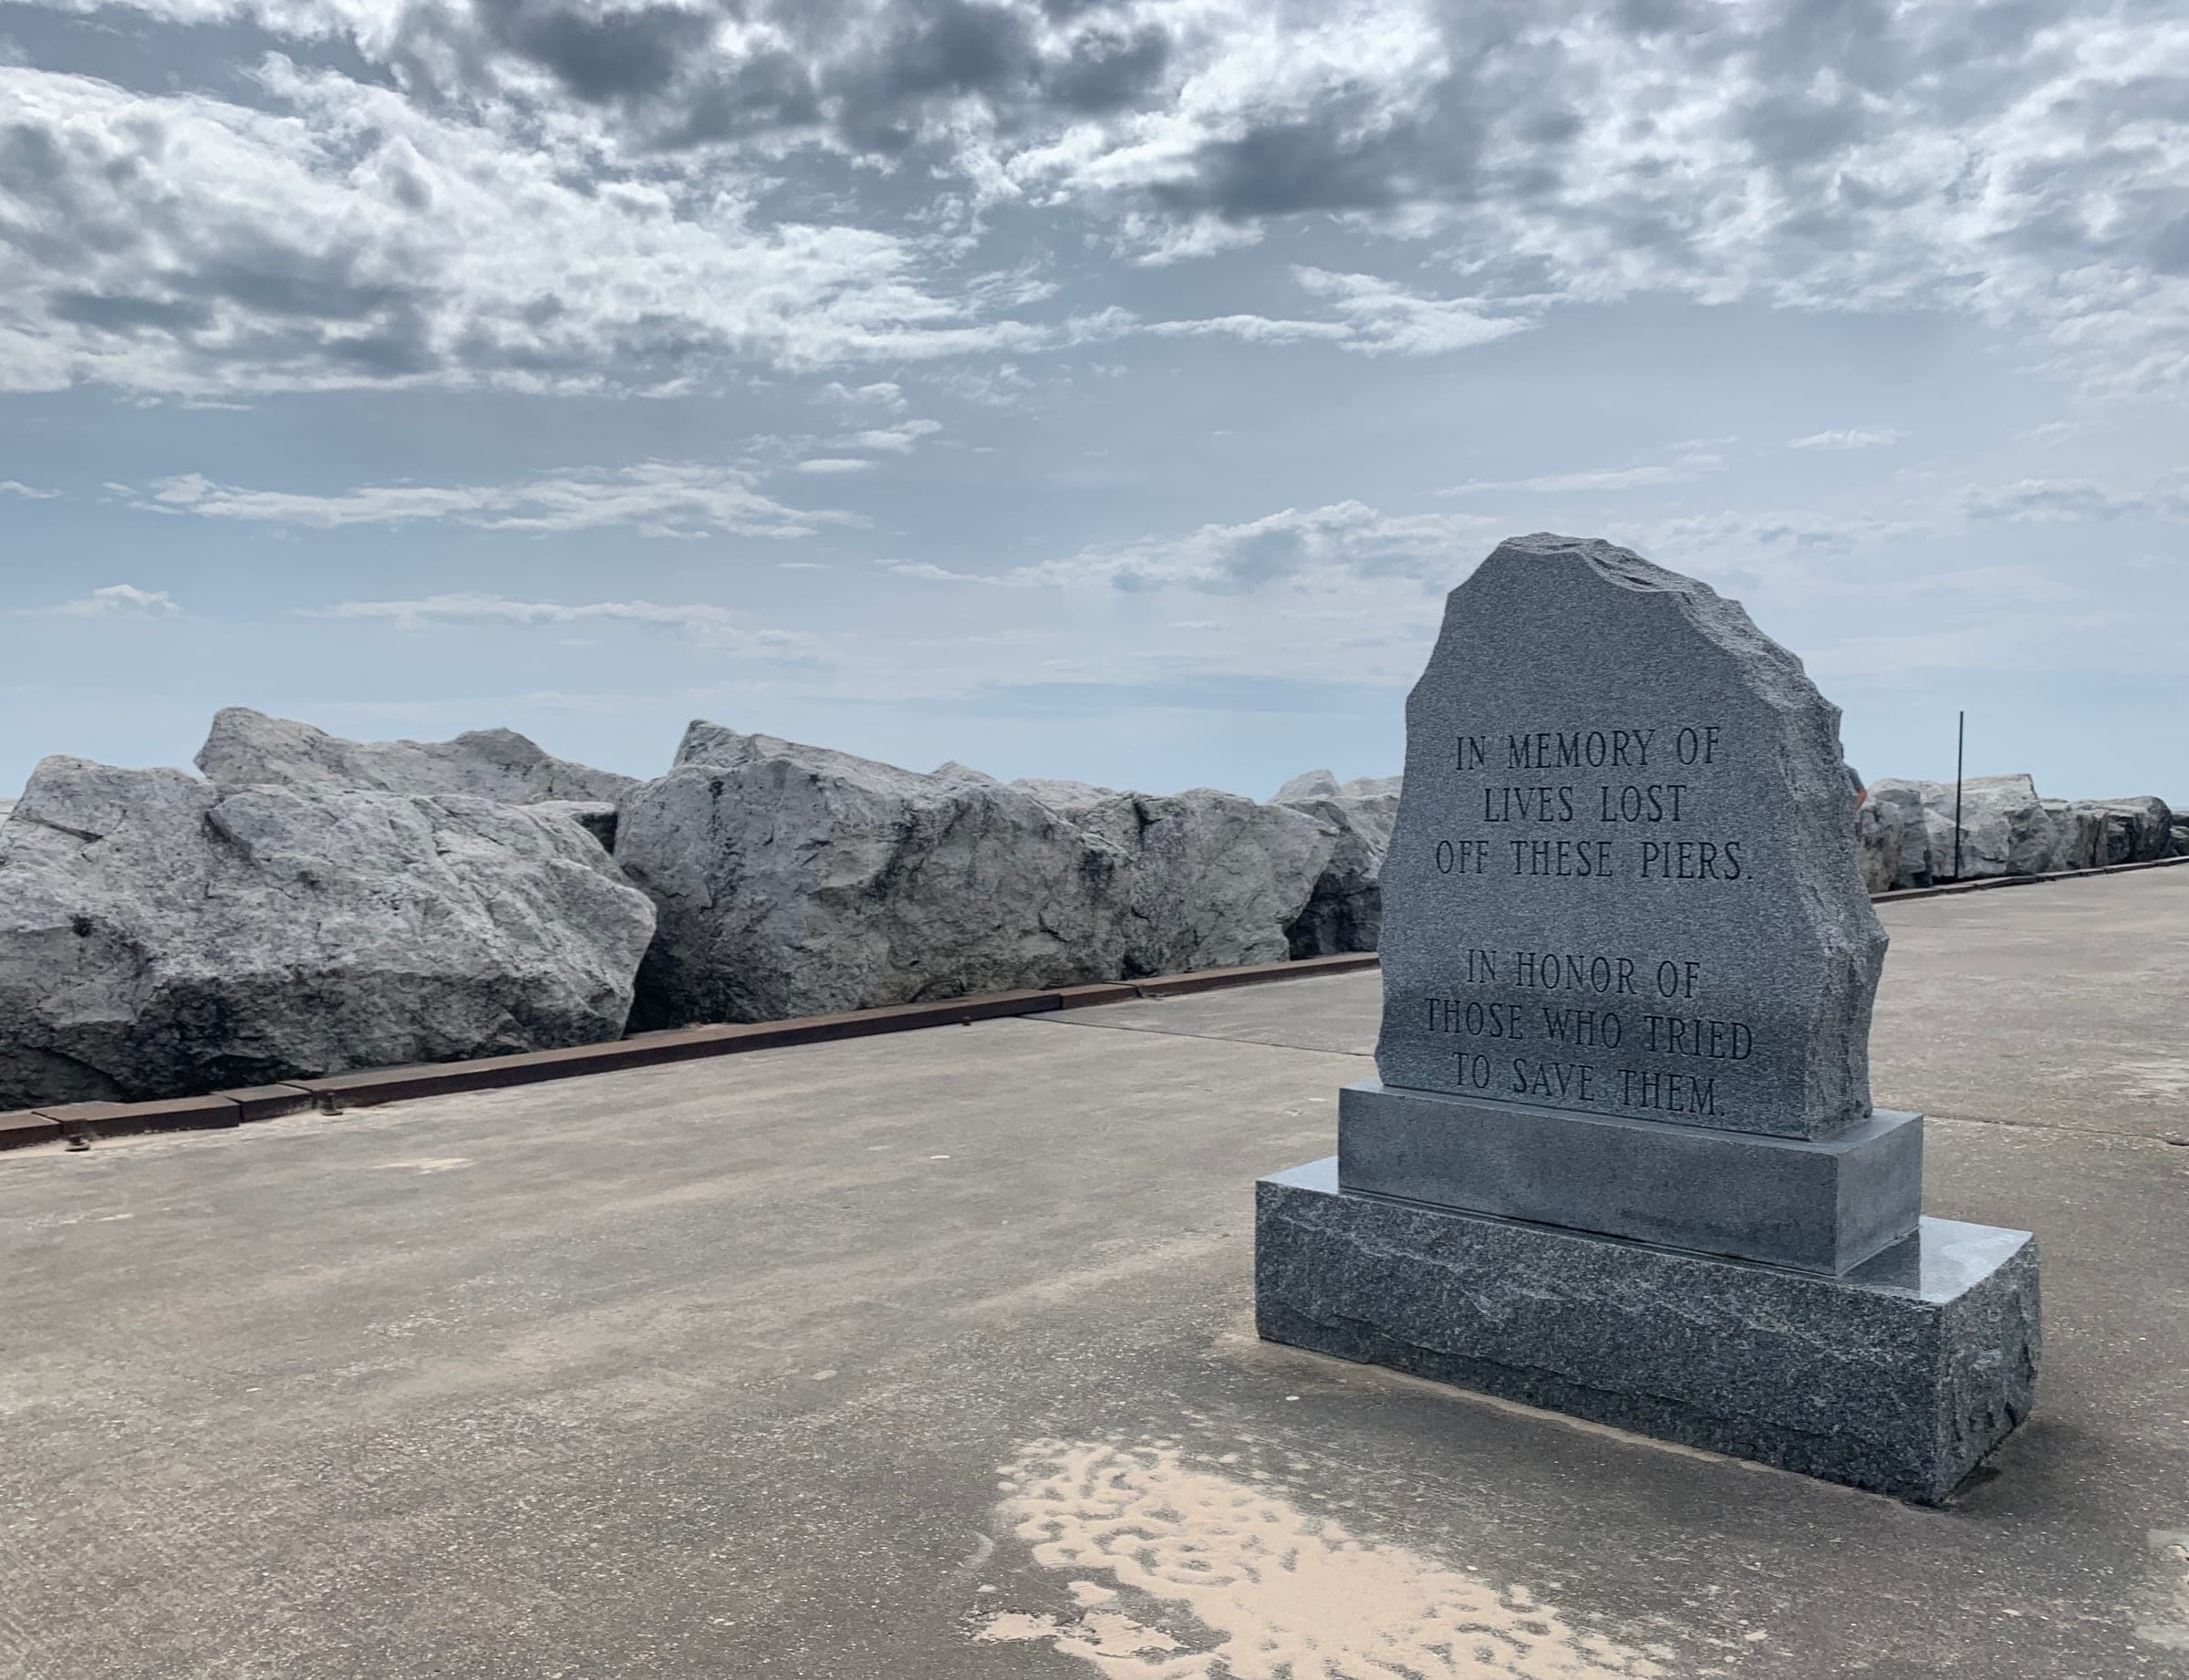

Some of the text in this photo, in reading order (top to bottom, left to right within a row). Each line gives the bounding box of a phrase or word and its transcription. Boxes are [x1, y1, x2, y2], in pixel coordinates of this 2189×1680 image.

[1456, 726, 1721, 771] IN MEMORY OF
[1484, 784, 1687, 823] LIVES LOST
[1435, 840, 1753, 881] OFF THESE PIERS.
[1467, 949, 1700, 999] IN HONOR OF
[1425, 998, 1752, 1061] THOSE WHO TRIED
[1453, 1052, 1725, 1117] TO SAVE THEM.
